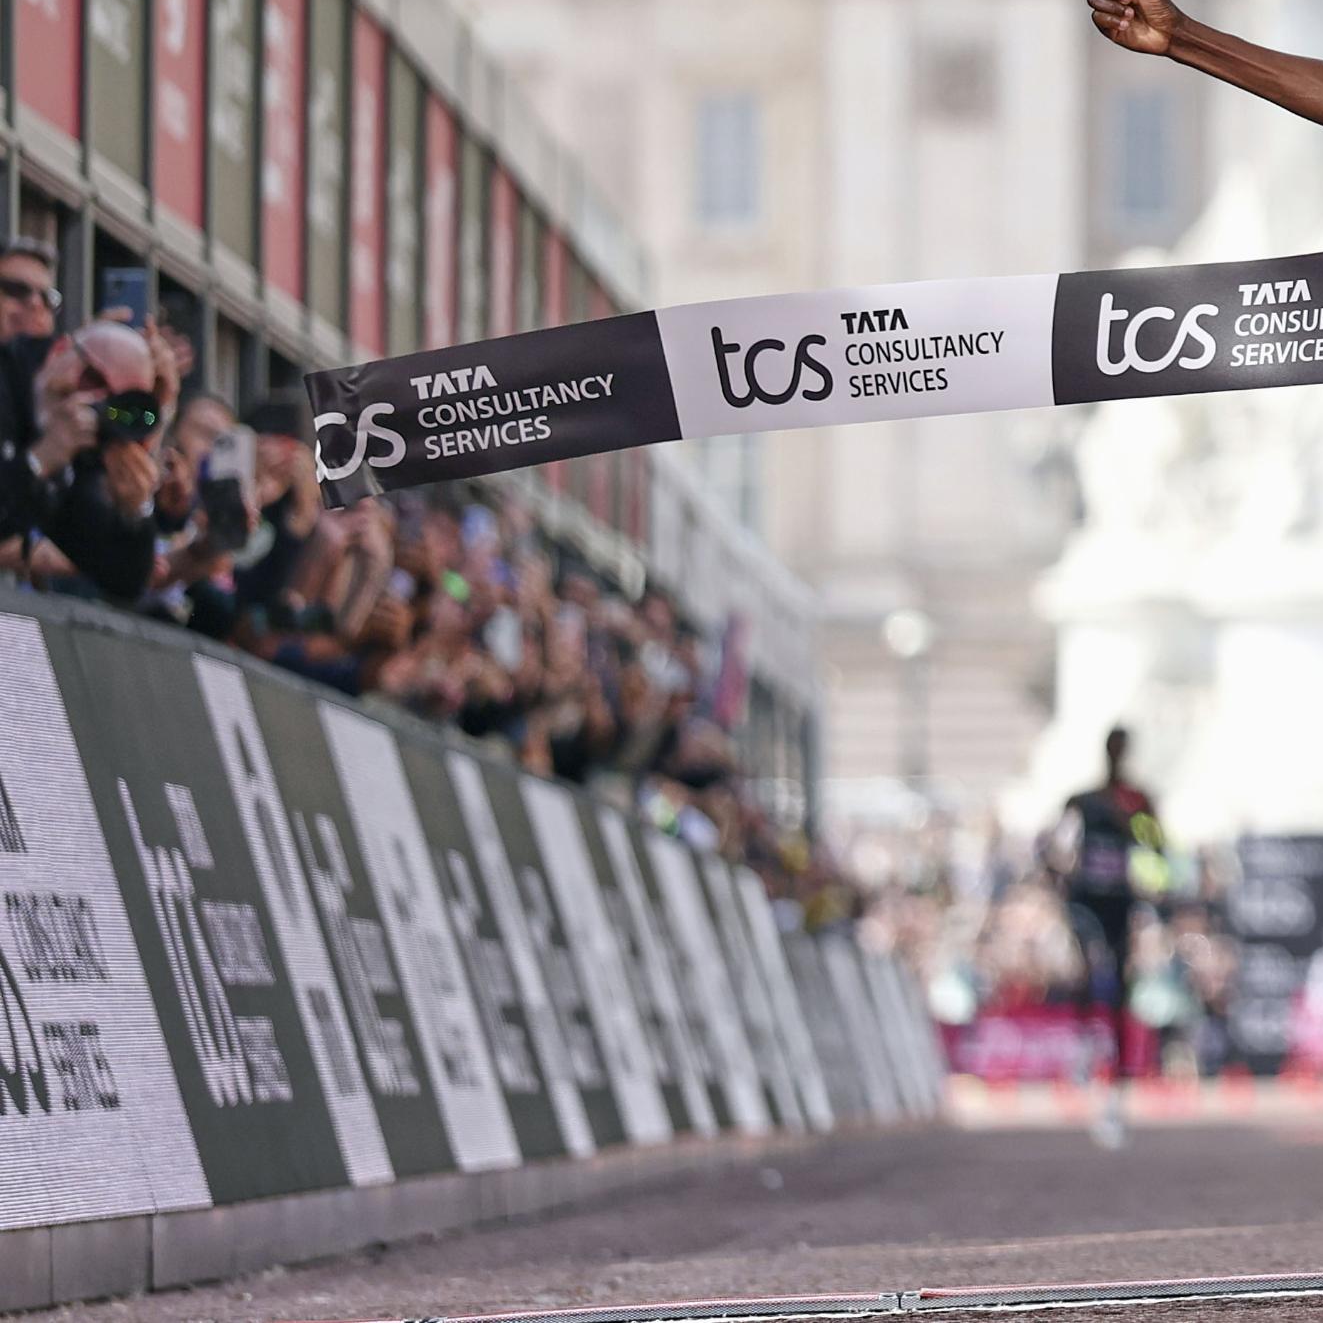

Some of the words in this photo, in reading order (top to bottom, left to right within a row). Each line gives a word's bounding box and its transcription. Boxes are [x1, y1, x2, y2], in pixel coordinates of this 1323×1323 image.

[1238, 279, 1312, 306] TATA
[840, 308, 909, 335] TATA
[1096, 292, 1219, 376] tcs
[710, 326, 834, 409] tcs
[845, 331, 1005, 367] CONSULTANCY
[410, 365, 499, 401] TATA
[417, 374, 615, 429] CONSULTANCY
[849, 368, 949, 398] SERVICES
[314, 402, 407, 484] cs
[424, 415, 552, 460] SERVICES
